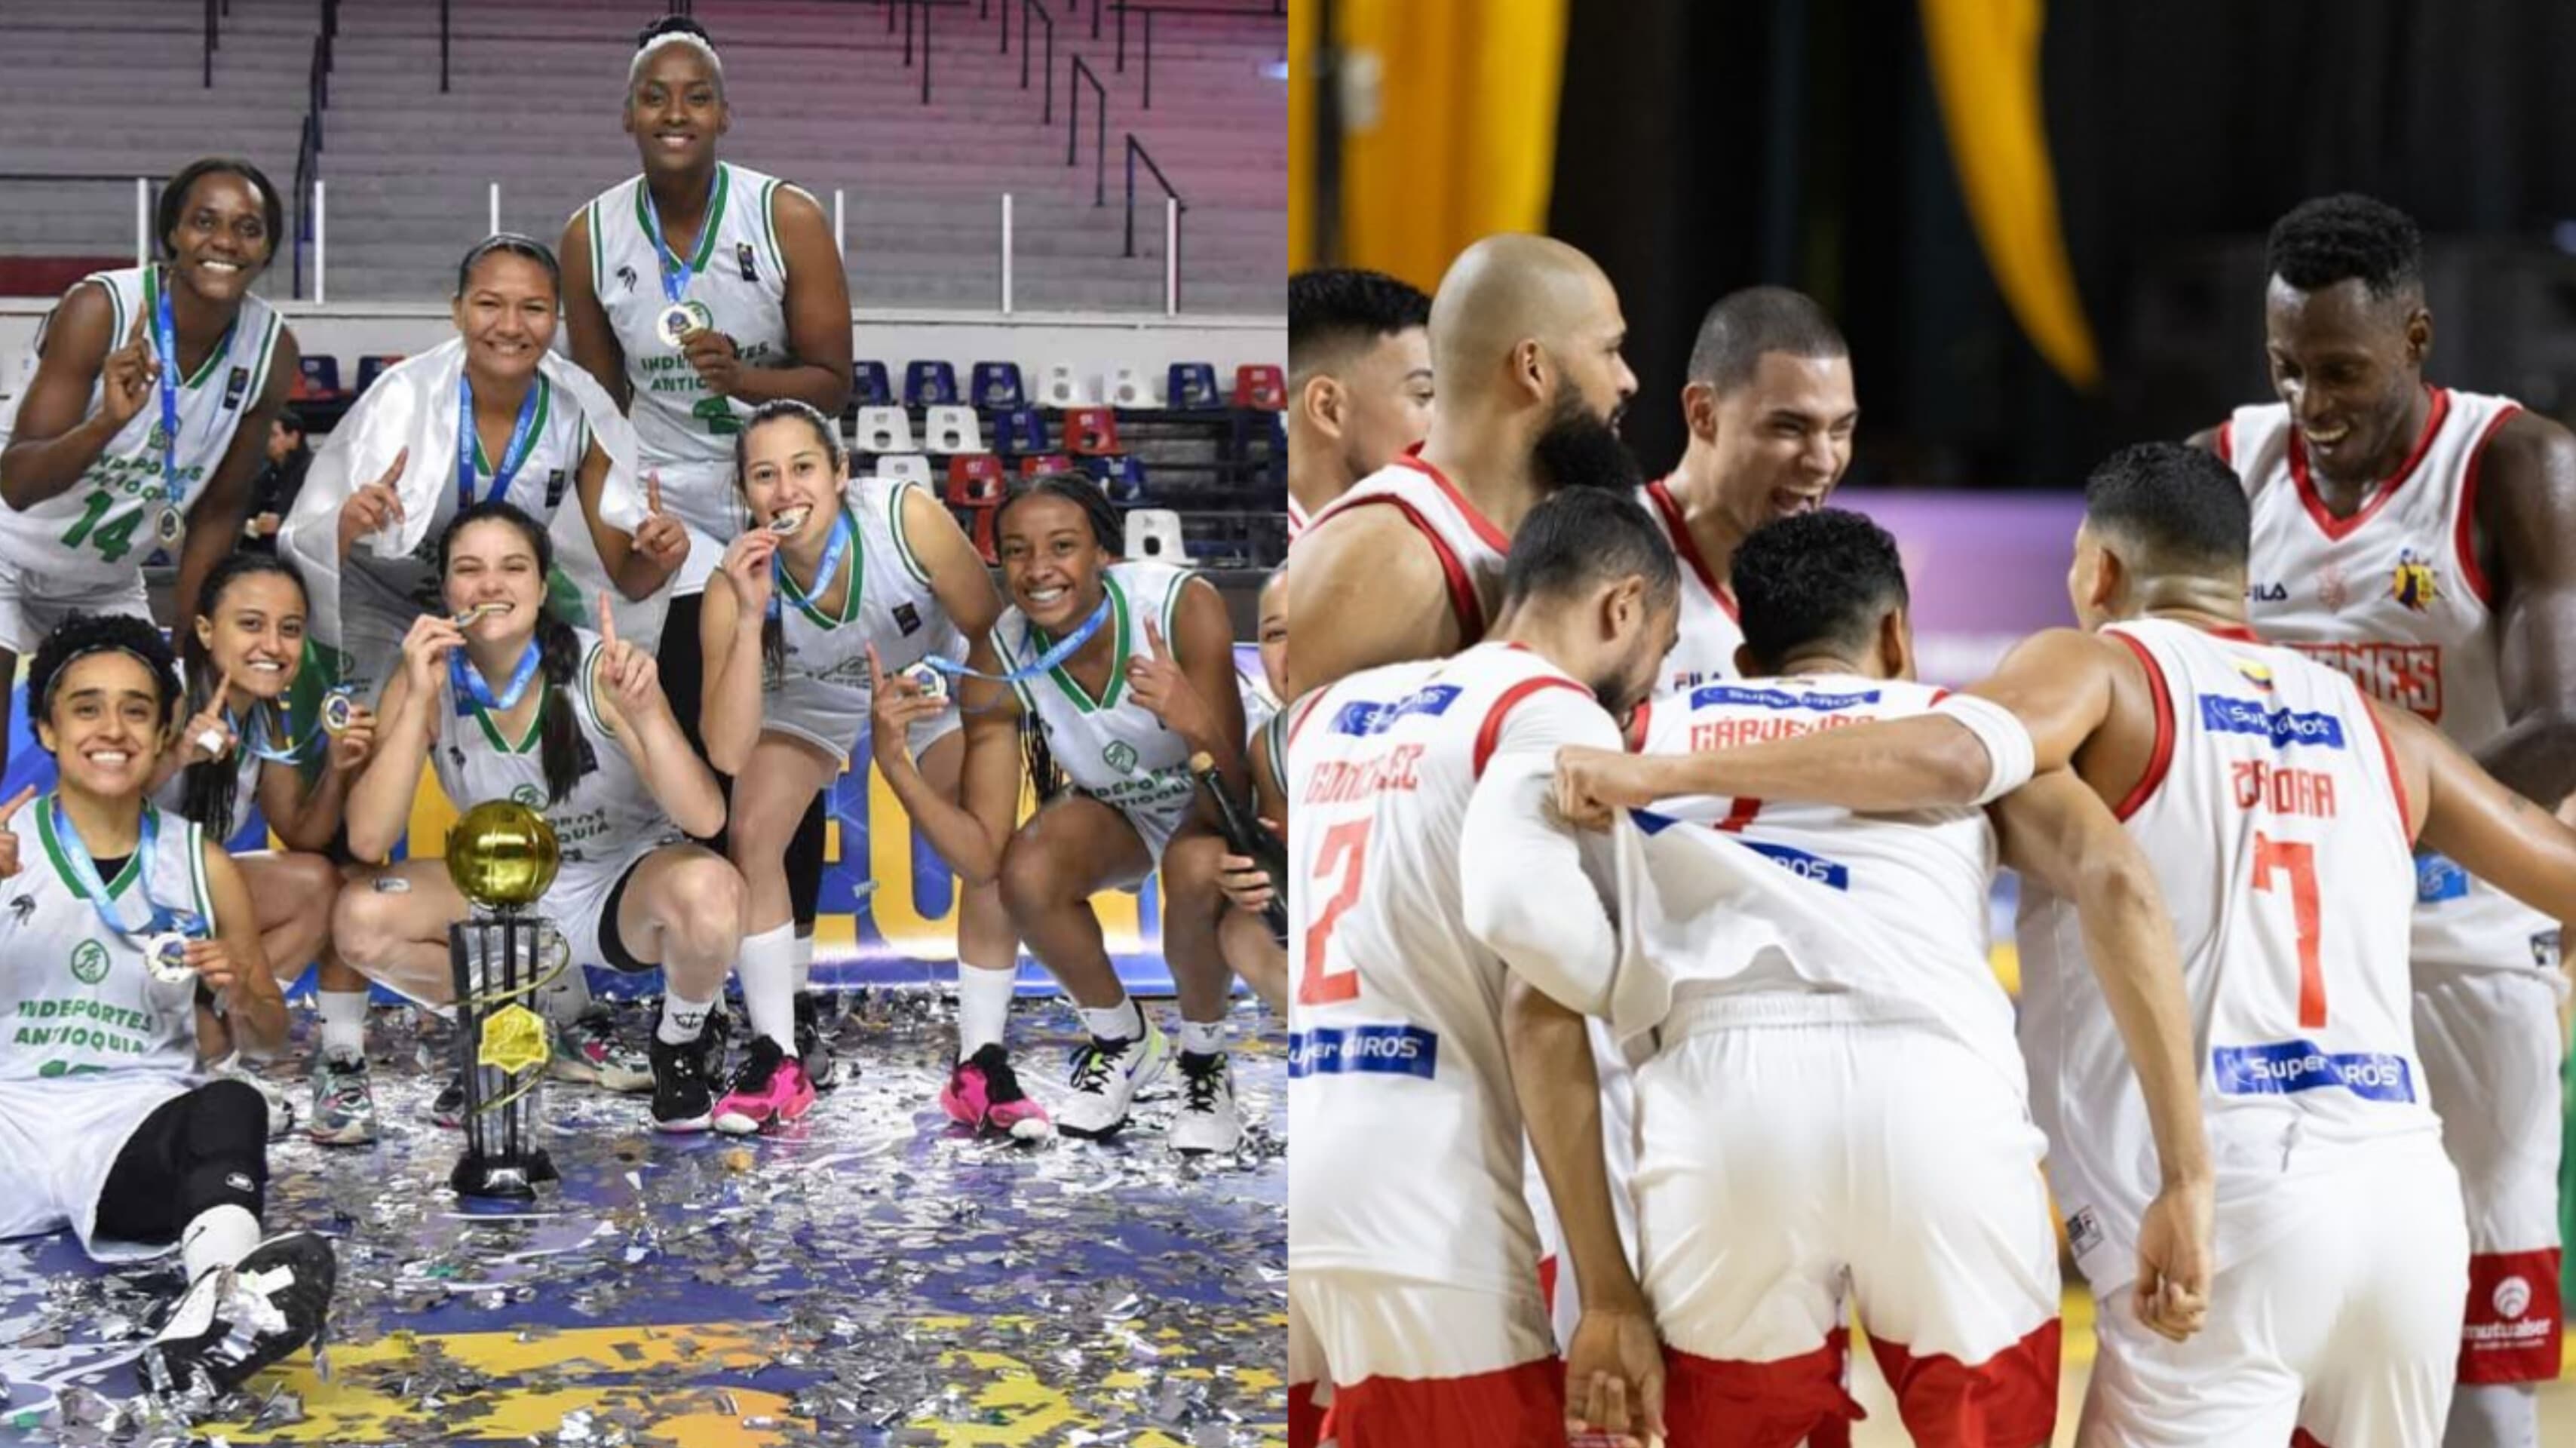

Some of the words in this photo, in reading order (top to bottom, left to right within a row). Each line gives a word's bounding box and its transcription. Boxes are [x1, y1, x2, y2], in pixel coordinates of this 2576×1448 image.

[61, 490, 143, 563] 14
[1297, 816, 1372, 1006] 2
[2251, 830, 2327, 1028] 7
[1289, 1042, 1338, 1070] uper
[2251, 1055, 2326, 1081] Super
